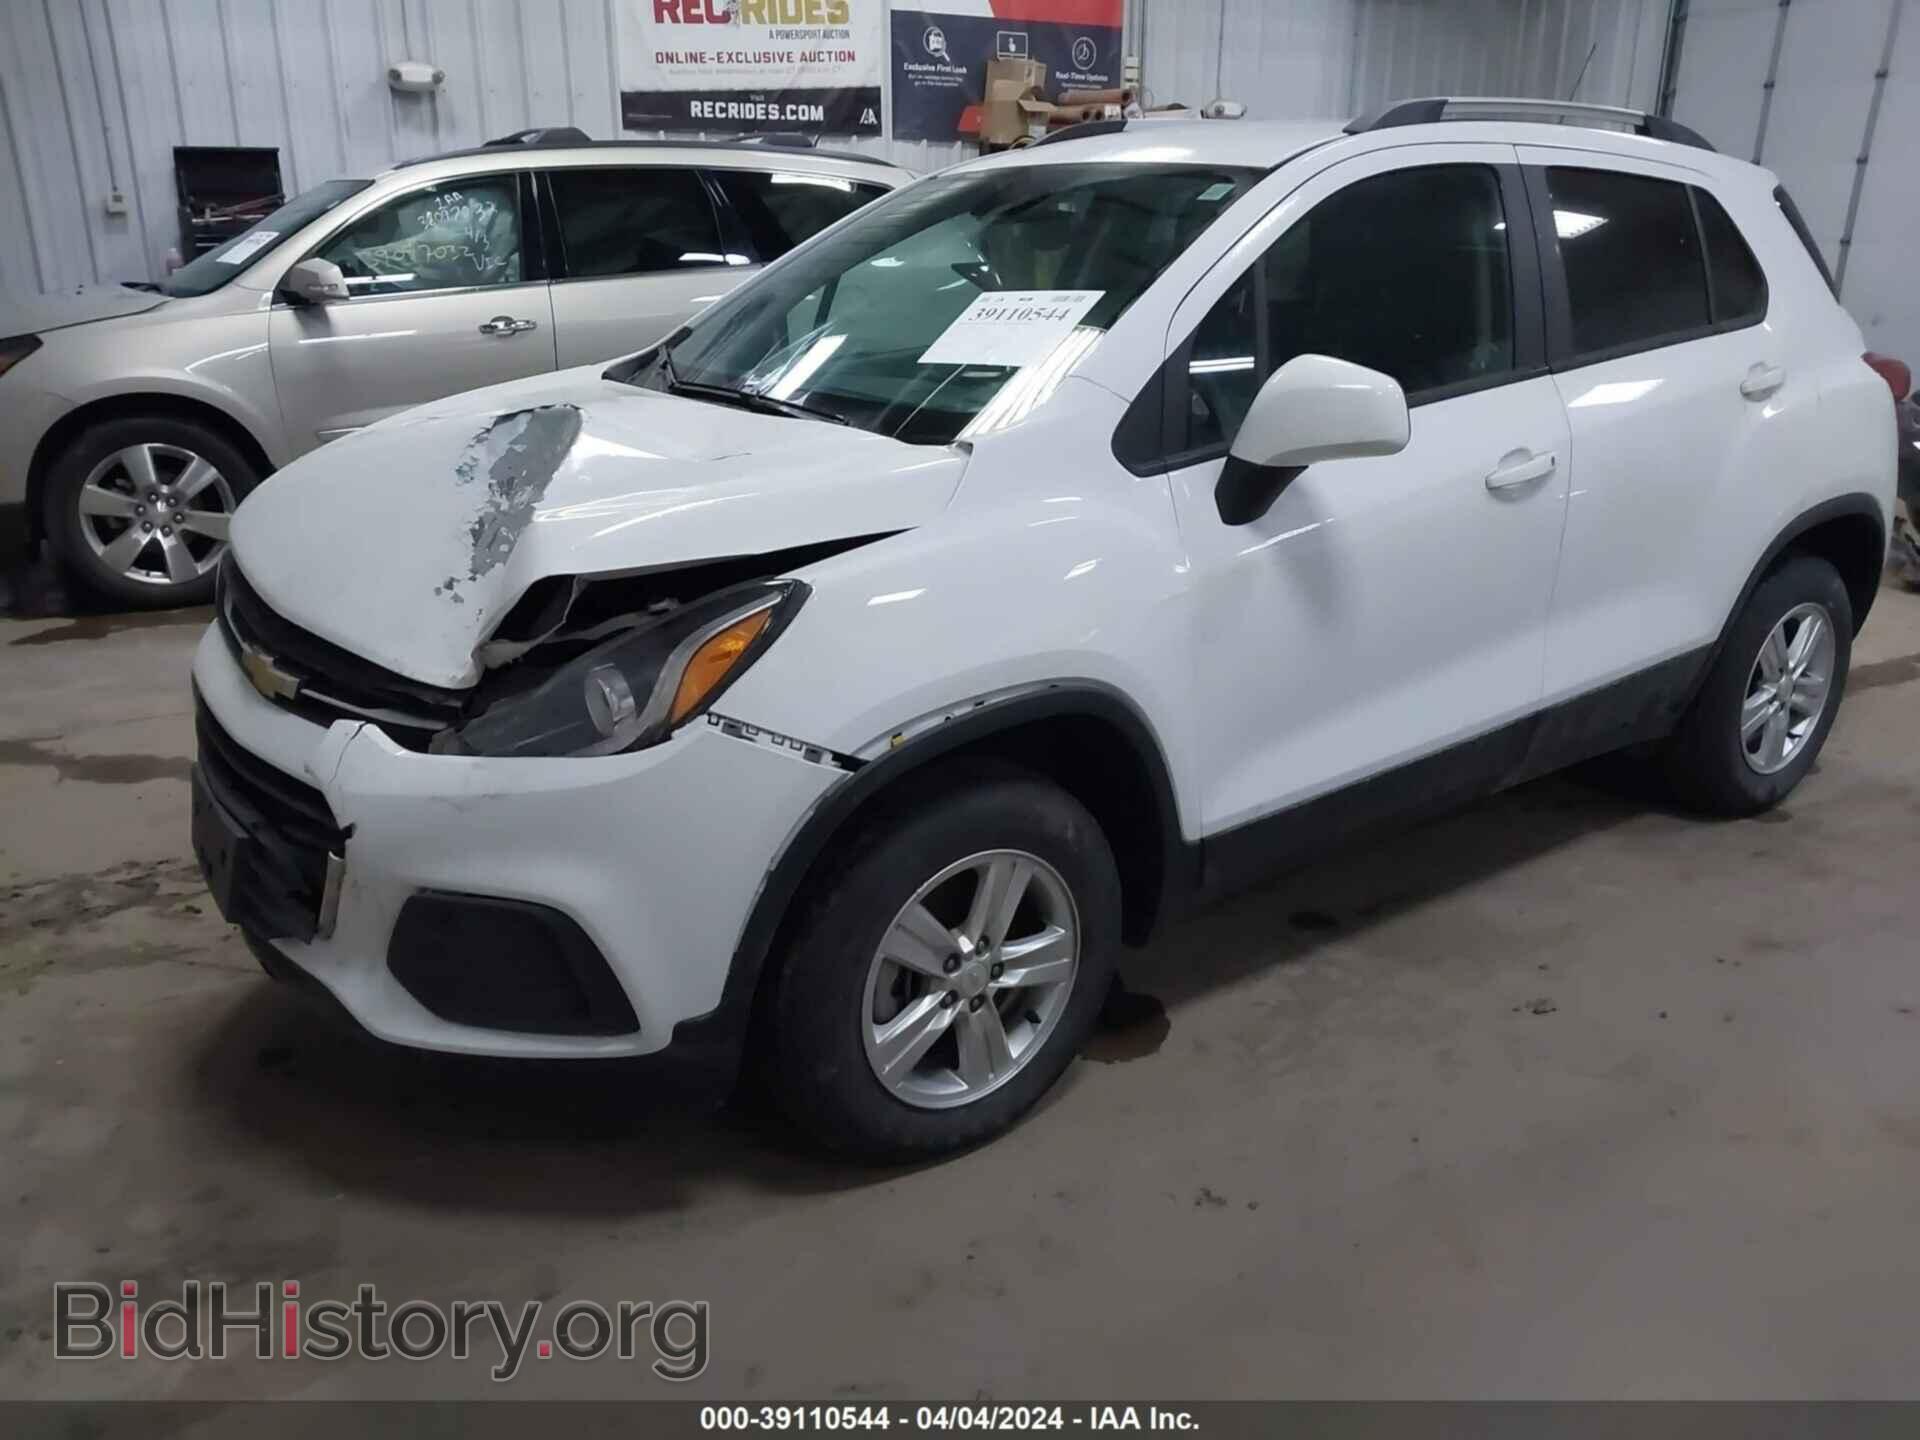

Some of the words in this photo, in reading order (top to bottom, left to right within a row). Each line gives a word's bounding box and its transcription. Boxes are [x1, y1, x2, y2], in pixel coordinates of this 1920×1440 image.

[653, 0, 731, 24] REC
[741, 0, 849, 25] RIDES
[823, 29, 850, 39] AUCTION
[655, 51, 794, 64] ONLINE-EXCLUSIVE
[799, 50, 856, 62] AUCTION
[690, 100, 824, 121] RECRIDES.COM
[967, 307, 1072, 321] 39110544
